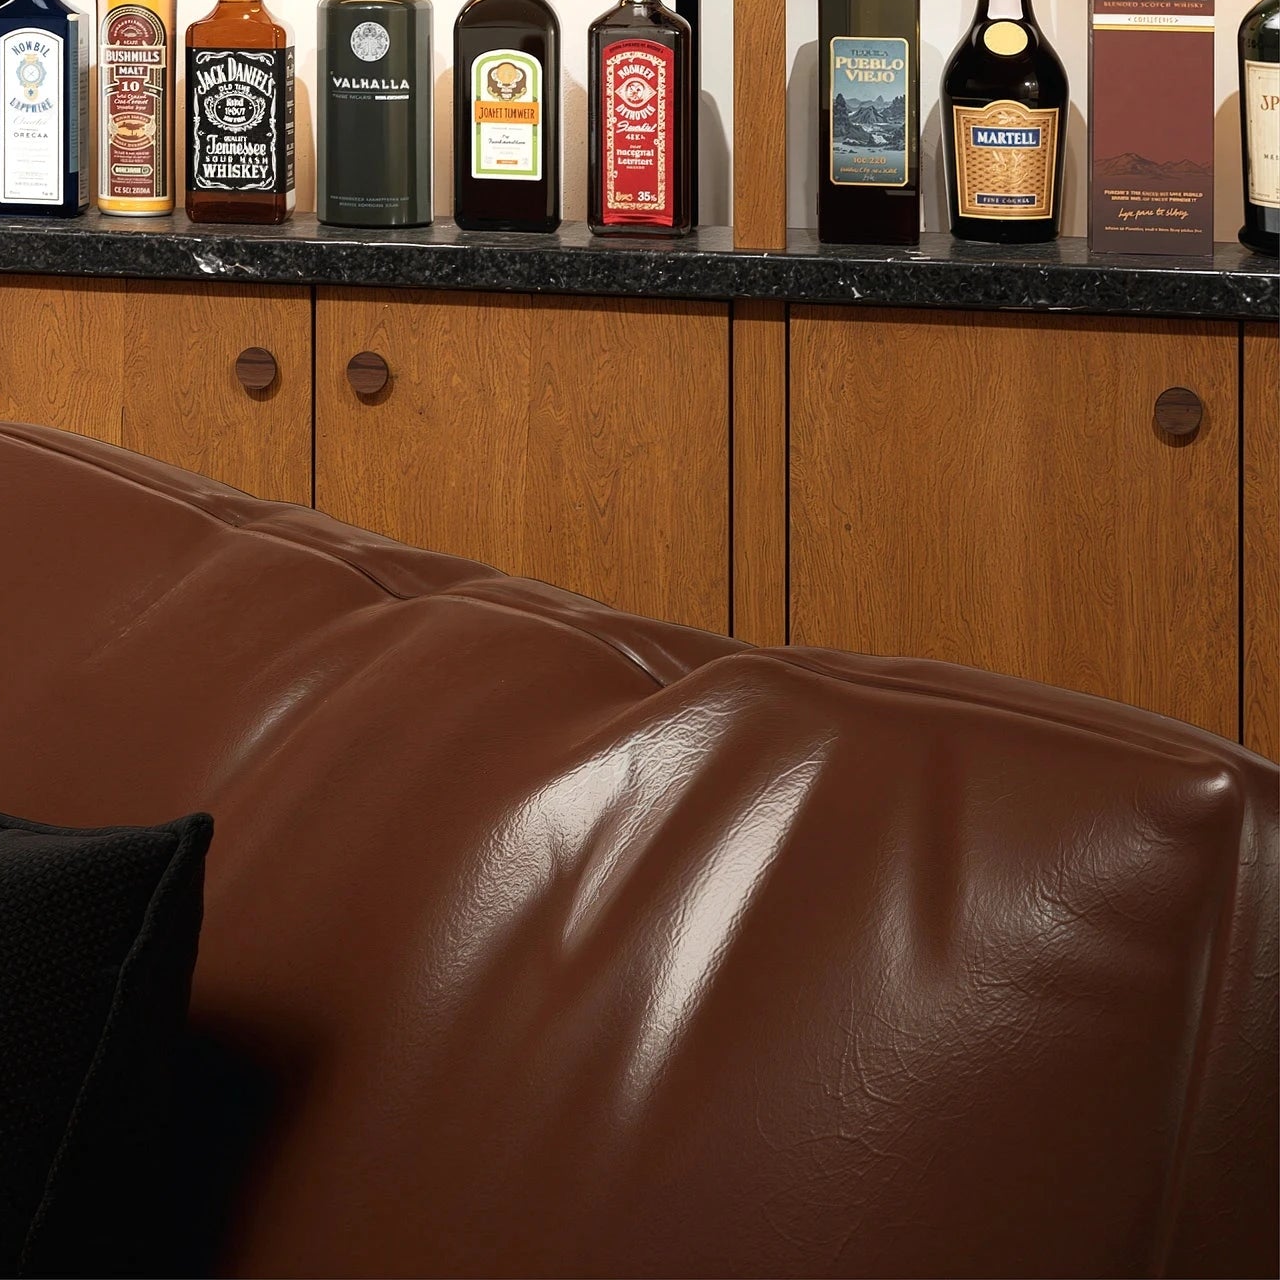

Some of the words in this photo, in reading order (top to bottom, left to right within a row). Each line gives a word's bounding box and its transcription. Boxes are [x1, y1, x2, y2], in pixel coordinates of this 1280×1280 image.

[835, 56, 904, 70] PUEBLO
[119, 67, 144, 75] MALT
[845, 70, 895, 83] VIEJO
[196, 65, 225, 93] JACK
[332, 76, 409, 90] VALHALLA
[121, 82, 140, 92] 10
[977, 131, 1037, 145] MARTELL
[206, 135, 266, 156] Tennessee
[203, 164, 268, 179] WHISKEY
